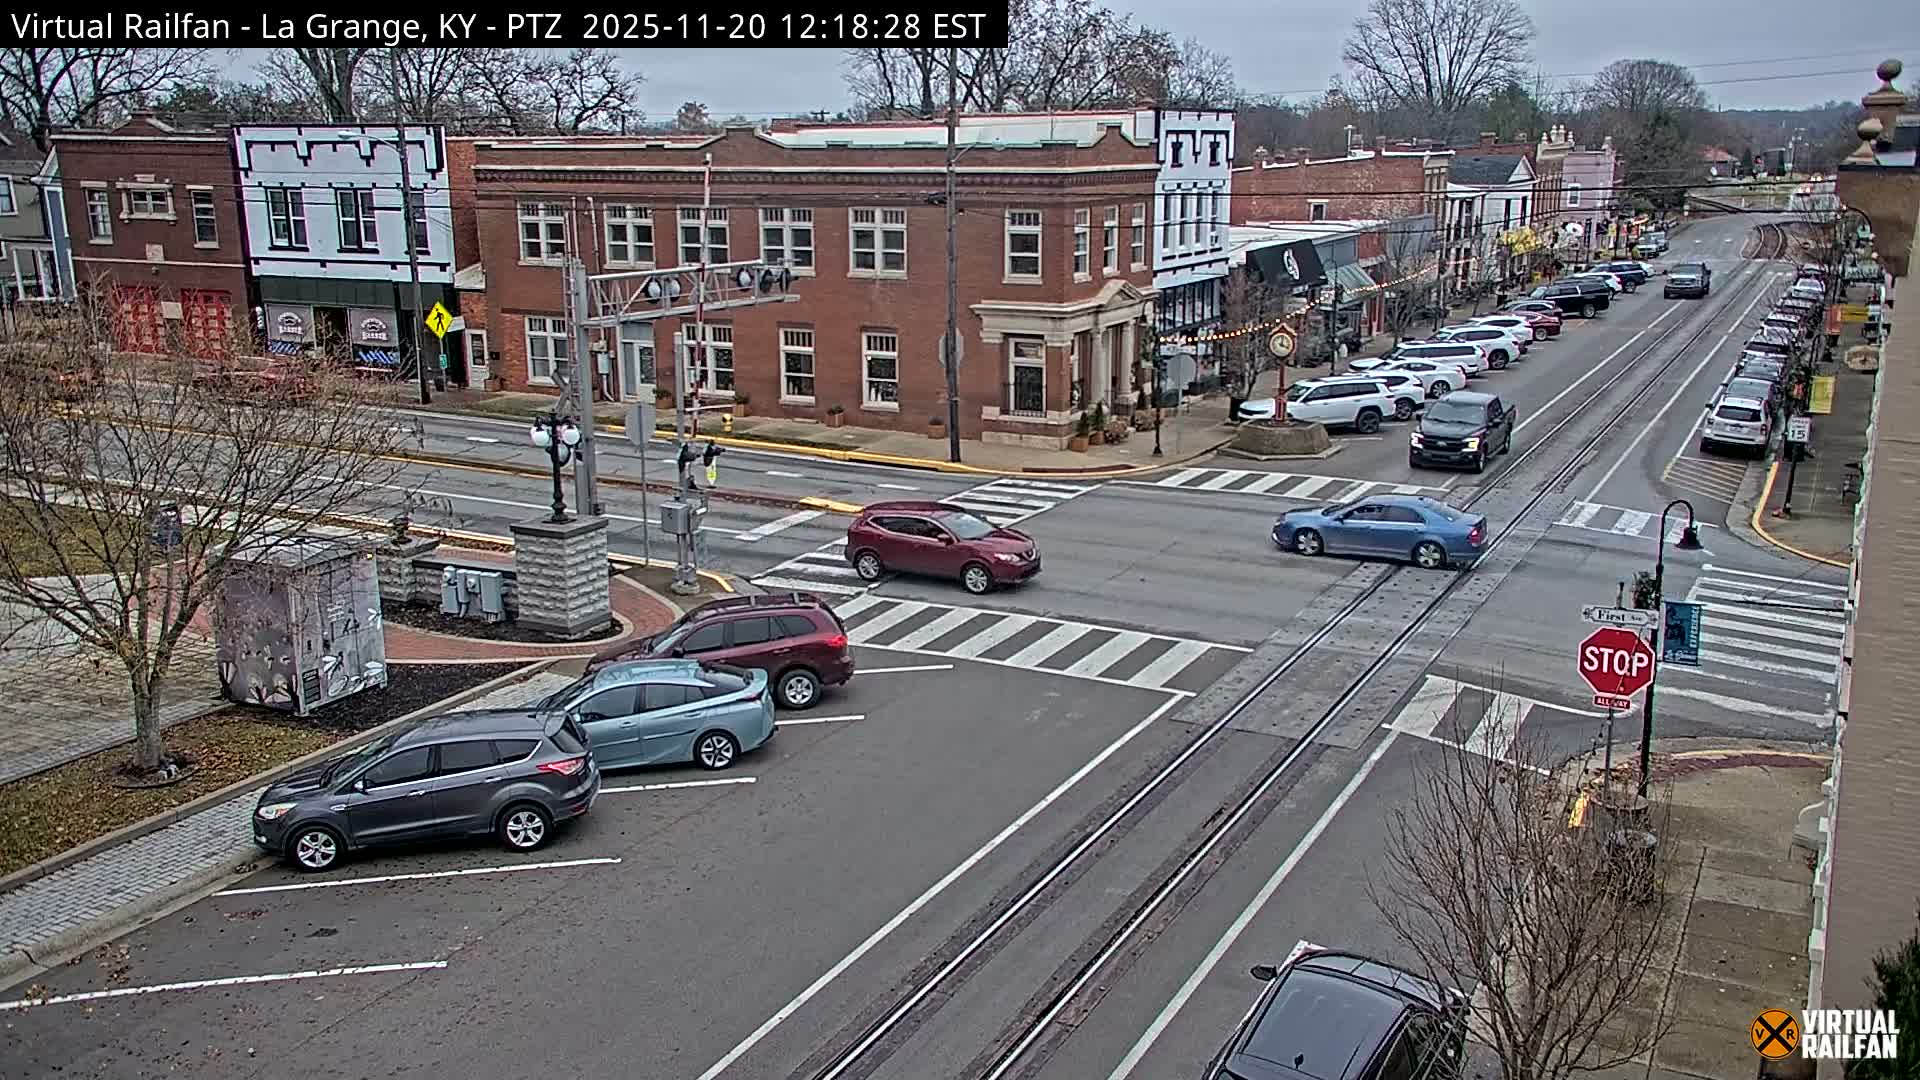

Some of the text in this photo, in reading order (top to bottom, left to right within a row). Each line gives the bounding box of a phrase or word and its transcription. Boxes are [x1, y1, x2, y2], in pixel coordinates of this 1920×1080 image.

[1791, 430, 1806, 439] 15
[1598, 609, 1625, 622] First
[1583, 646, 1649, 677] STOP
[1597, 697, 1609, 706] ALL
